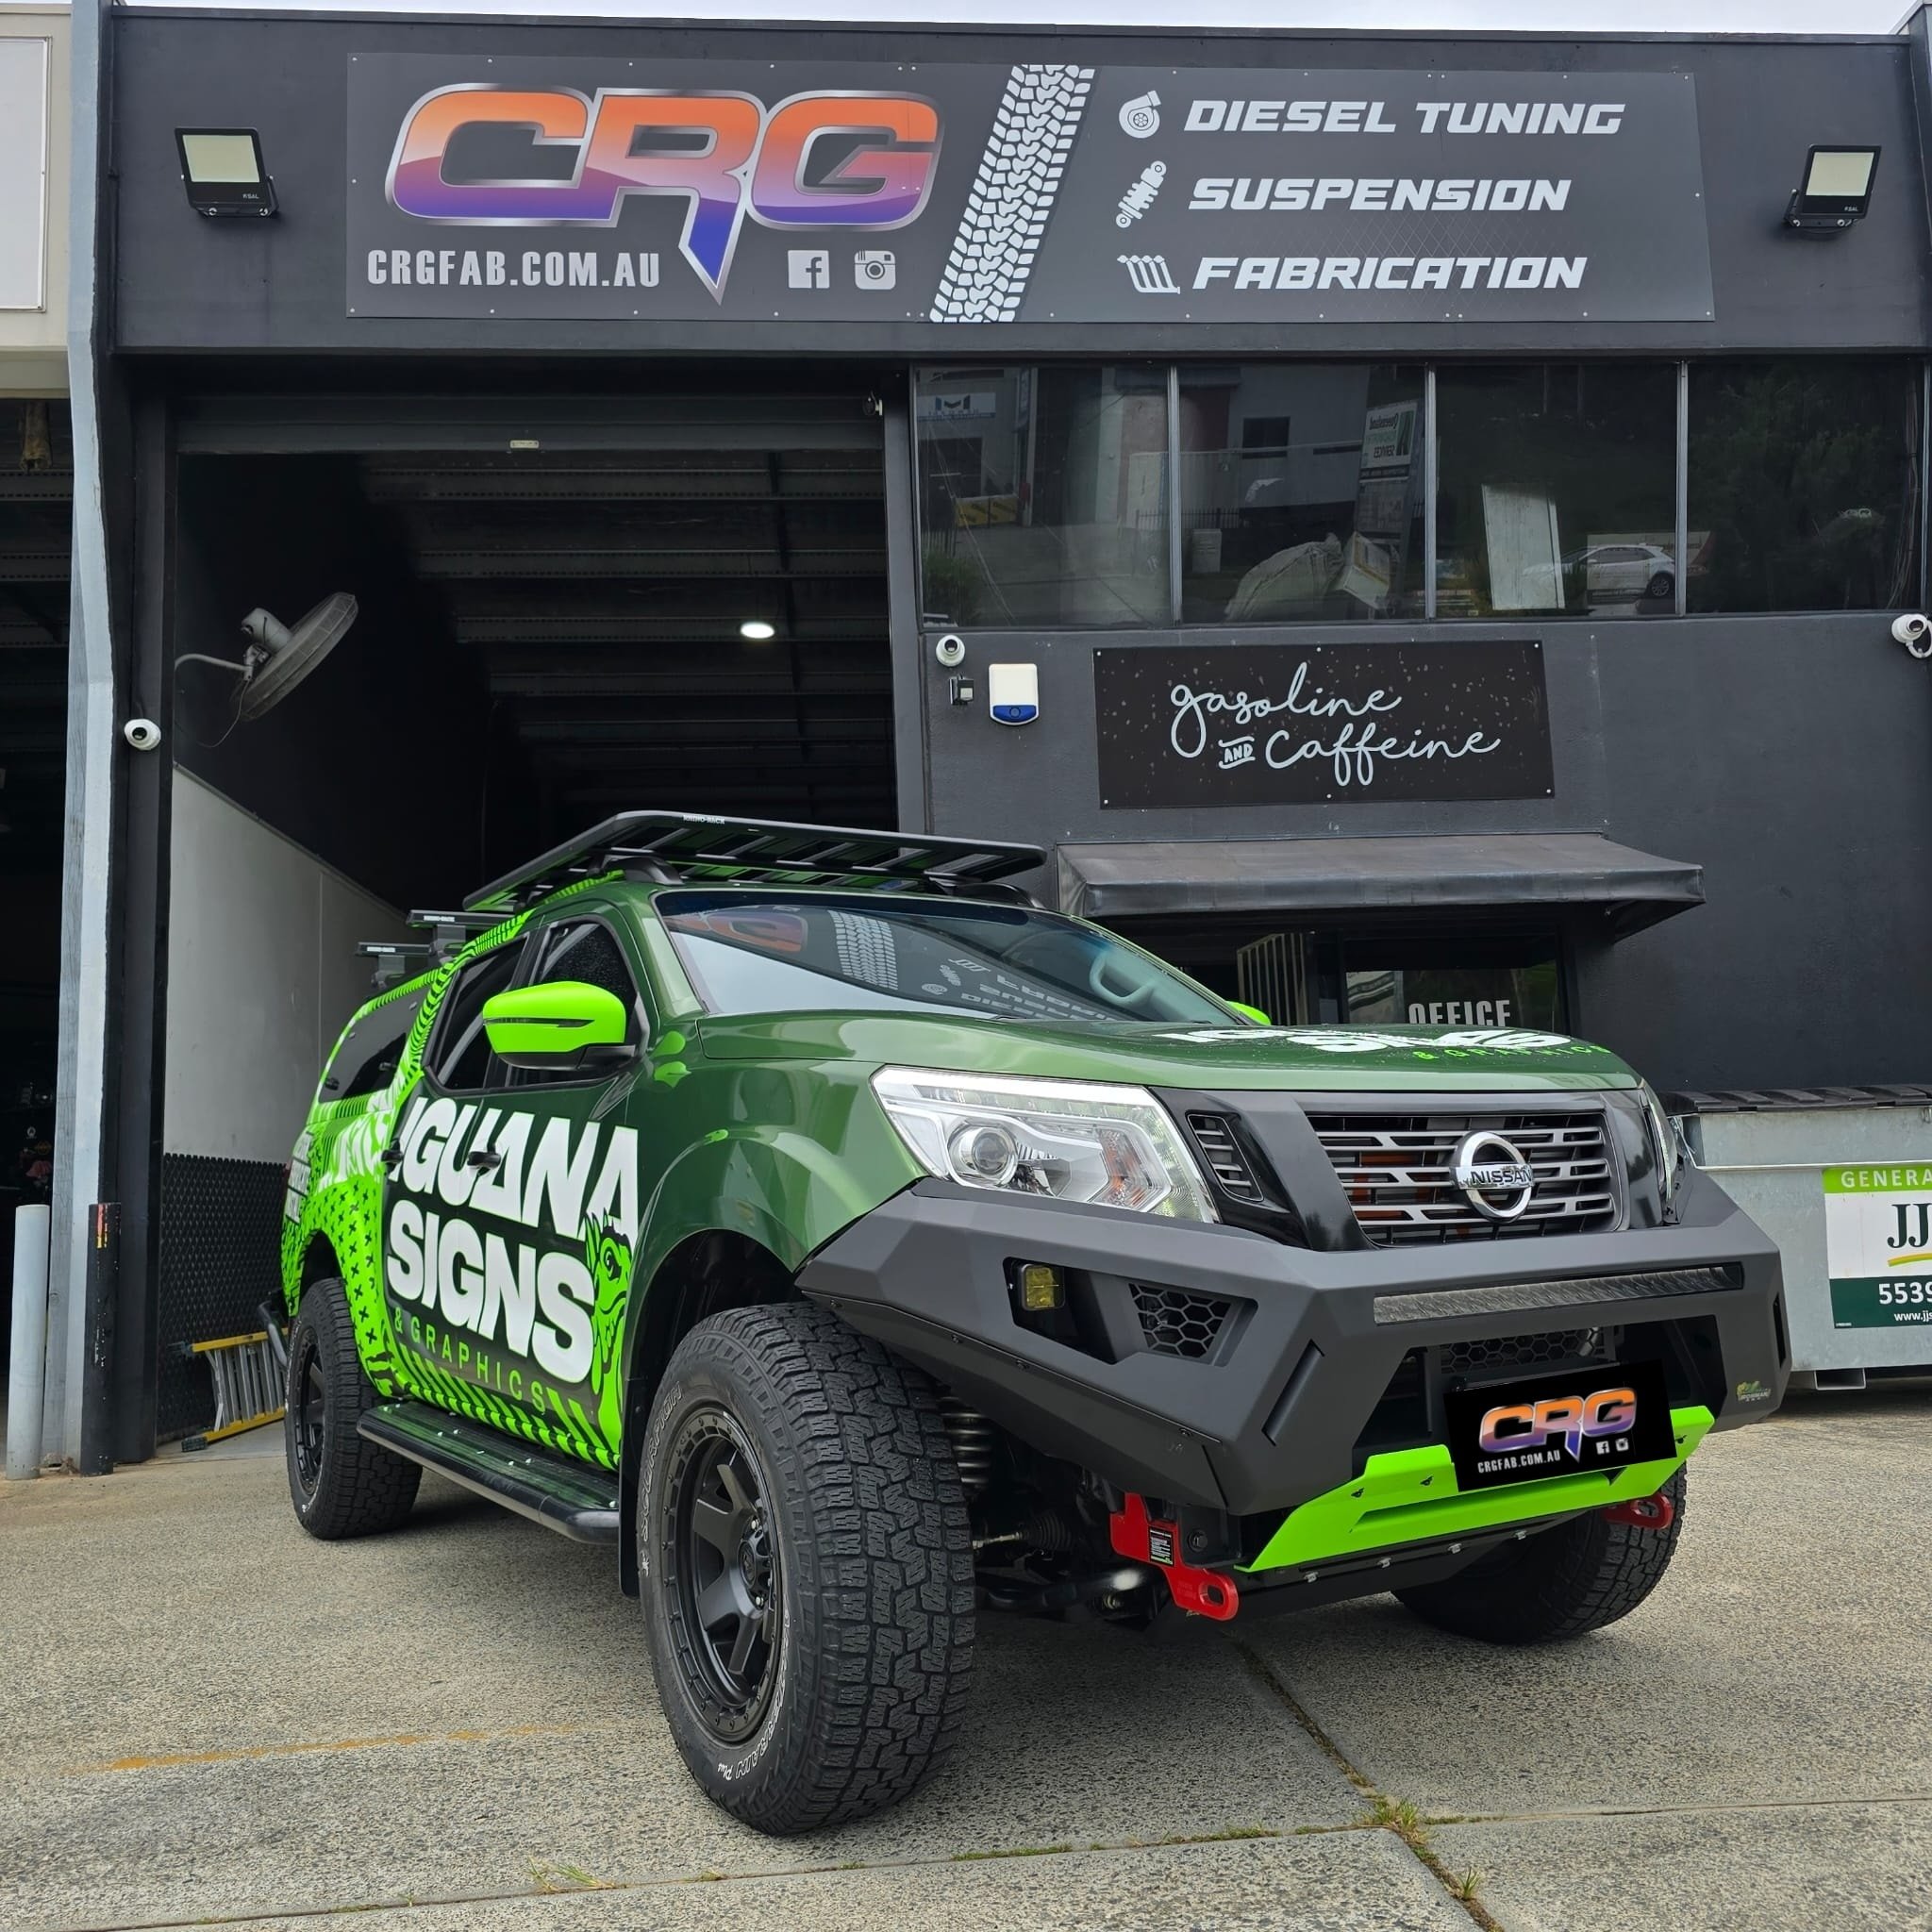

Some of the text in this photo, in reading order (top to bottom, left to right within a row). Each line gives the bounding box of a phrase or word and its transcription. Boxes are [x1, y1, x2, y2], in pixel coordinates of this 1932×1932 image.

[1184, 99, 1626, 135] DIESEL TUNING
[385, 82, 942, 304] CRG
[1188, 177, 1572, 211] SUSPENSION
[367, 249, 659, 288] CRGFAB.COM.AU
[1191, 256, 1588, 290] FABRICATION
[1170, 662, 1402, 758] gasoline
[1223, 741, 1255, 765] AND
[1408, 999, 1510, 1026] OFFICE
[389, 1096, 639, 1253] IGUANA
[1470, 1169, 1533, 1184] NISSAN
[387, 1199, 596, 1384] SIGNS
[393, 1306, 546, 1413] & GRAPHICS
[1479, 1387, 1638, 1462] CRG
[1477, 1449, 1561, 1474] CRGFAB.COM.AU
